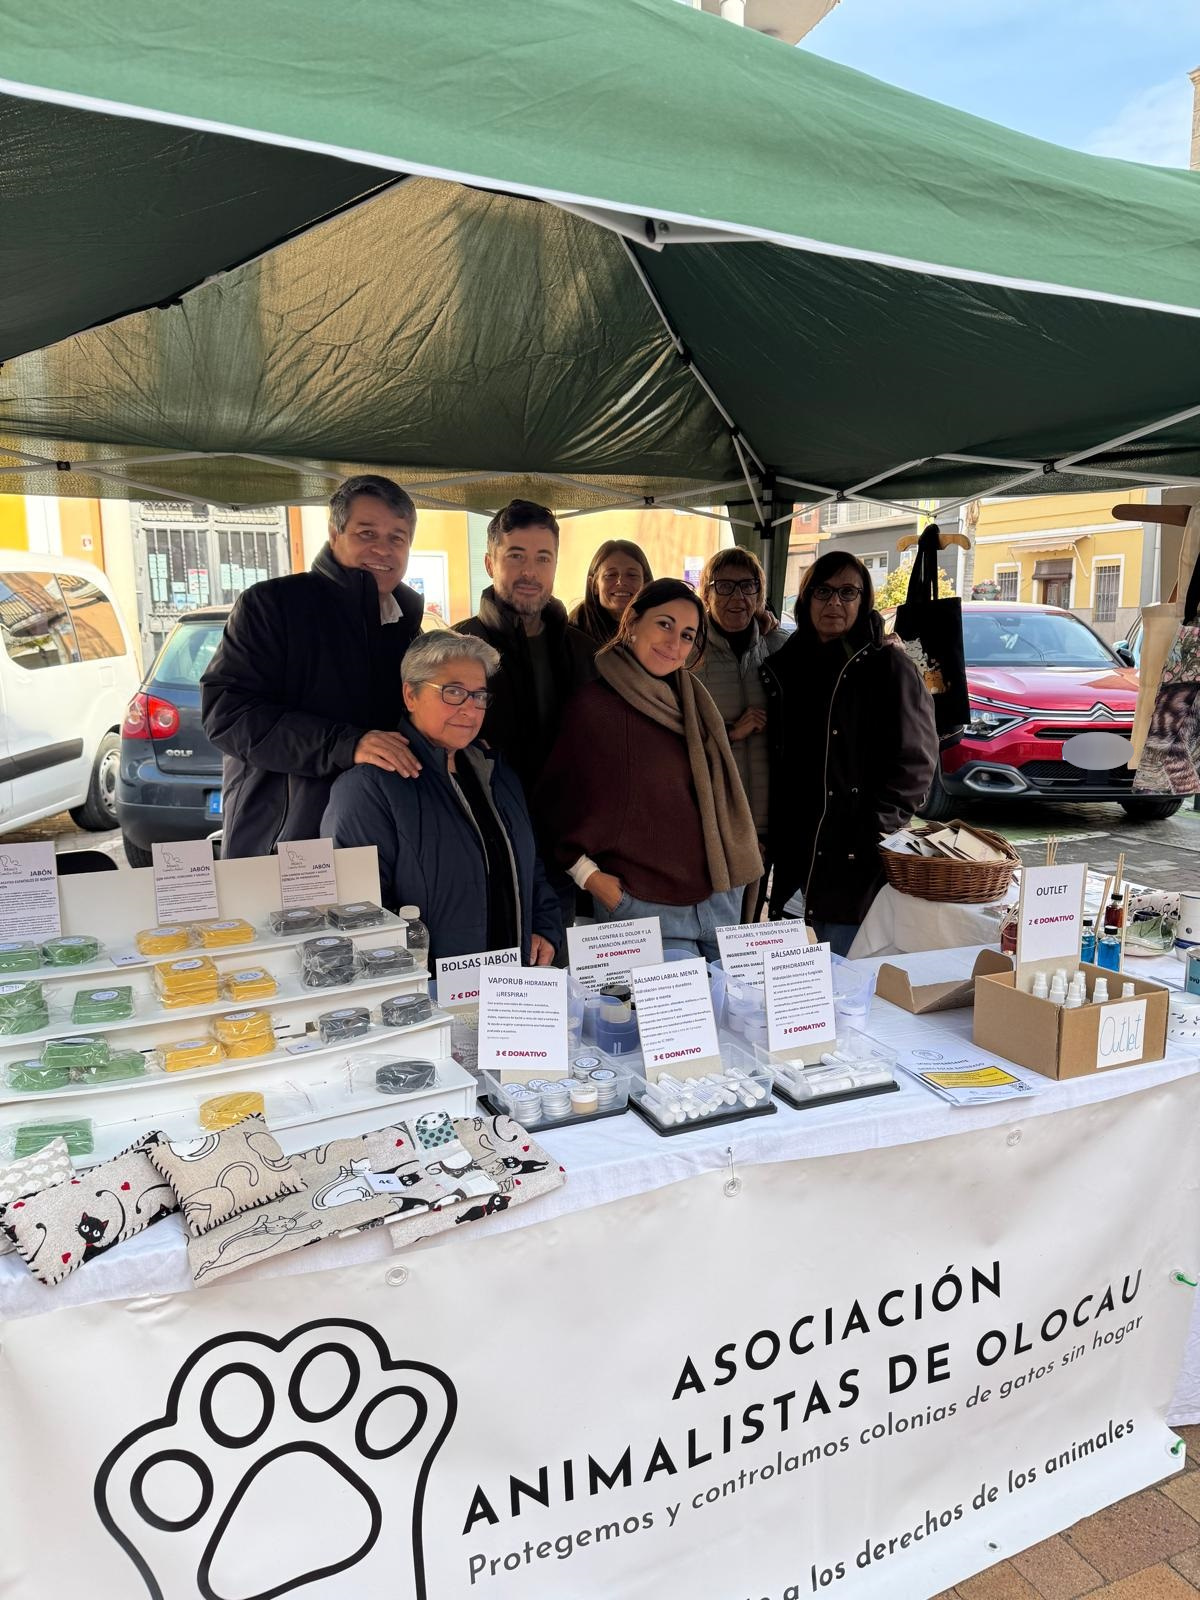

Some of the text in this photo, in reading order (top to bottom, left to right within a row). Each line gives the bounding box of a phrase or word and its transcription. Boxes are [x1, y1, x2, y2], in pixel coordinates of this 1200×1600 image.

[166, 749, 193, 757] GOLF
[30, 869, 52, 877] JABÓN
[190, 865, 210, 873] JABÓN
[1036, 884, 1068, 897] OUTLET
[1040, 914, 1075, 924] DONATIVO
[599, 933, 618, 941] CONTRA
[760, 929, 778, 937] TENSIÓN
[621, 938, 647, 946] ARTICULAR
[609, 948, 641, 957] DONATIVO
[727, 950, 757, 958] INGREDIENTES
[771, 945, 823, 959] BÁLSAMO LABIAL
[441, 951, 518, 972] BOLSAS JABÓN
[576, 962, 610, 971] INGREDIENTES
[771, 960, 815, 972] HIPERHIDRATANTE
[488, 976, 523, 986] VAPORUB
[633, 969, 699, 985] BÁLSAMO LABIAL MENTA
[793, 1021, 826, 1033] DONATIVO
[1100, 1014, 1142, 1056] Outlet
[508, 1050, 548, 1058] DONATIVO
[665, 1047, 702, 1059] DONATIVO
[672, 1261, 1001, 1400] ASOCIACIÓN
[461, 1269, 1143, 1536] ANIMALISTAS DE OLOCAU
[468, 1315, 1144, 1585] Protegemos y controlamos colonias de gatos sin hogar
[783, 1416, 1135, 1600] a los derechos de los animales
